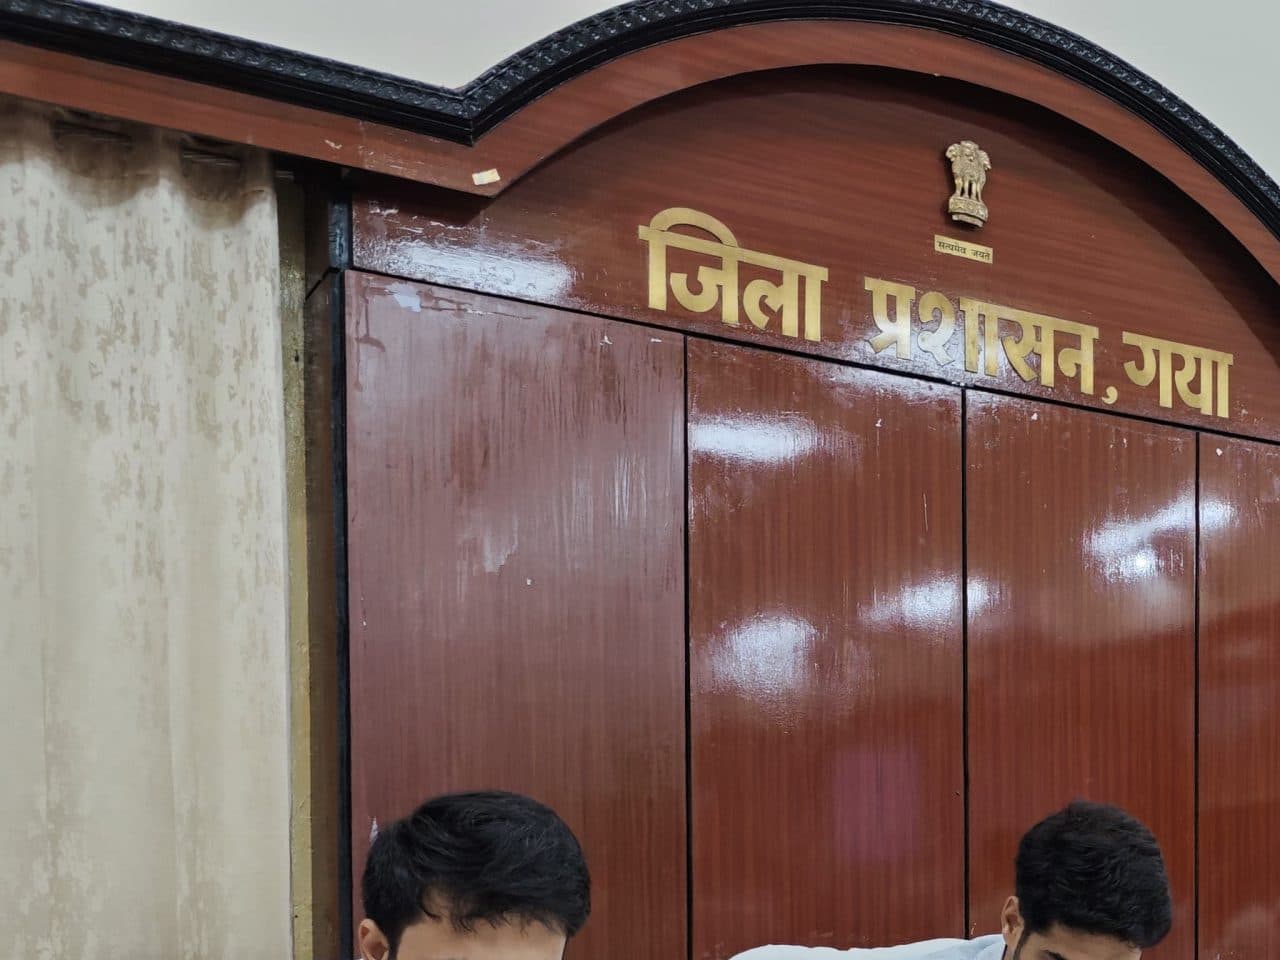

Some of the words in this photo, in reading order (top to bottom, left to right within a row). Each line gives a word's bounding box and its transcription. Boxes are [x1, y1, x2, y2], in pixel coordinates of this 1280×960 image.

[937, 240, 967, 254] सत्यमेव
[971, 247, 991, 260] जयते
[638, 207, 829, 342] जिला
[1122, 331, 1234, 418] गया
